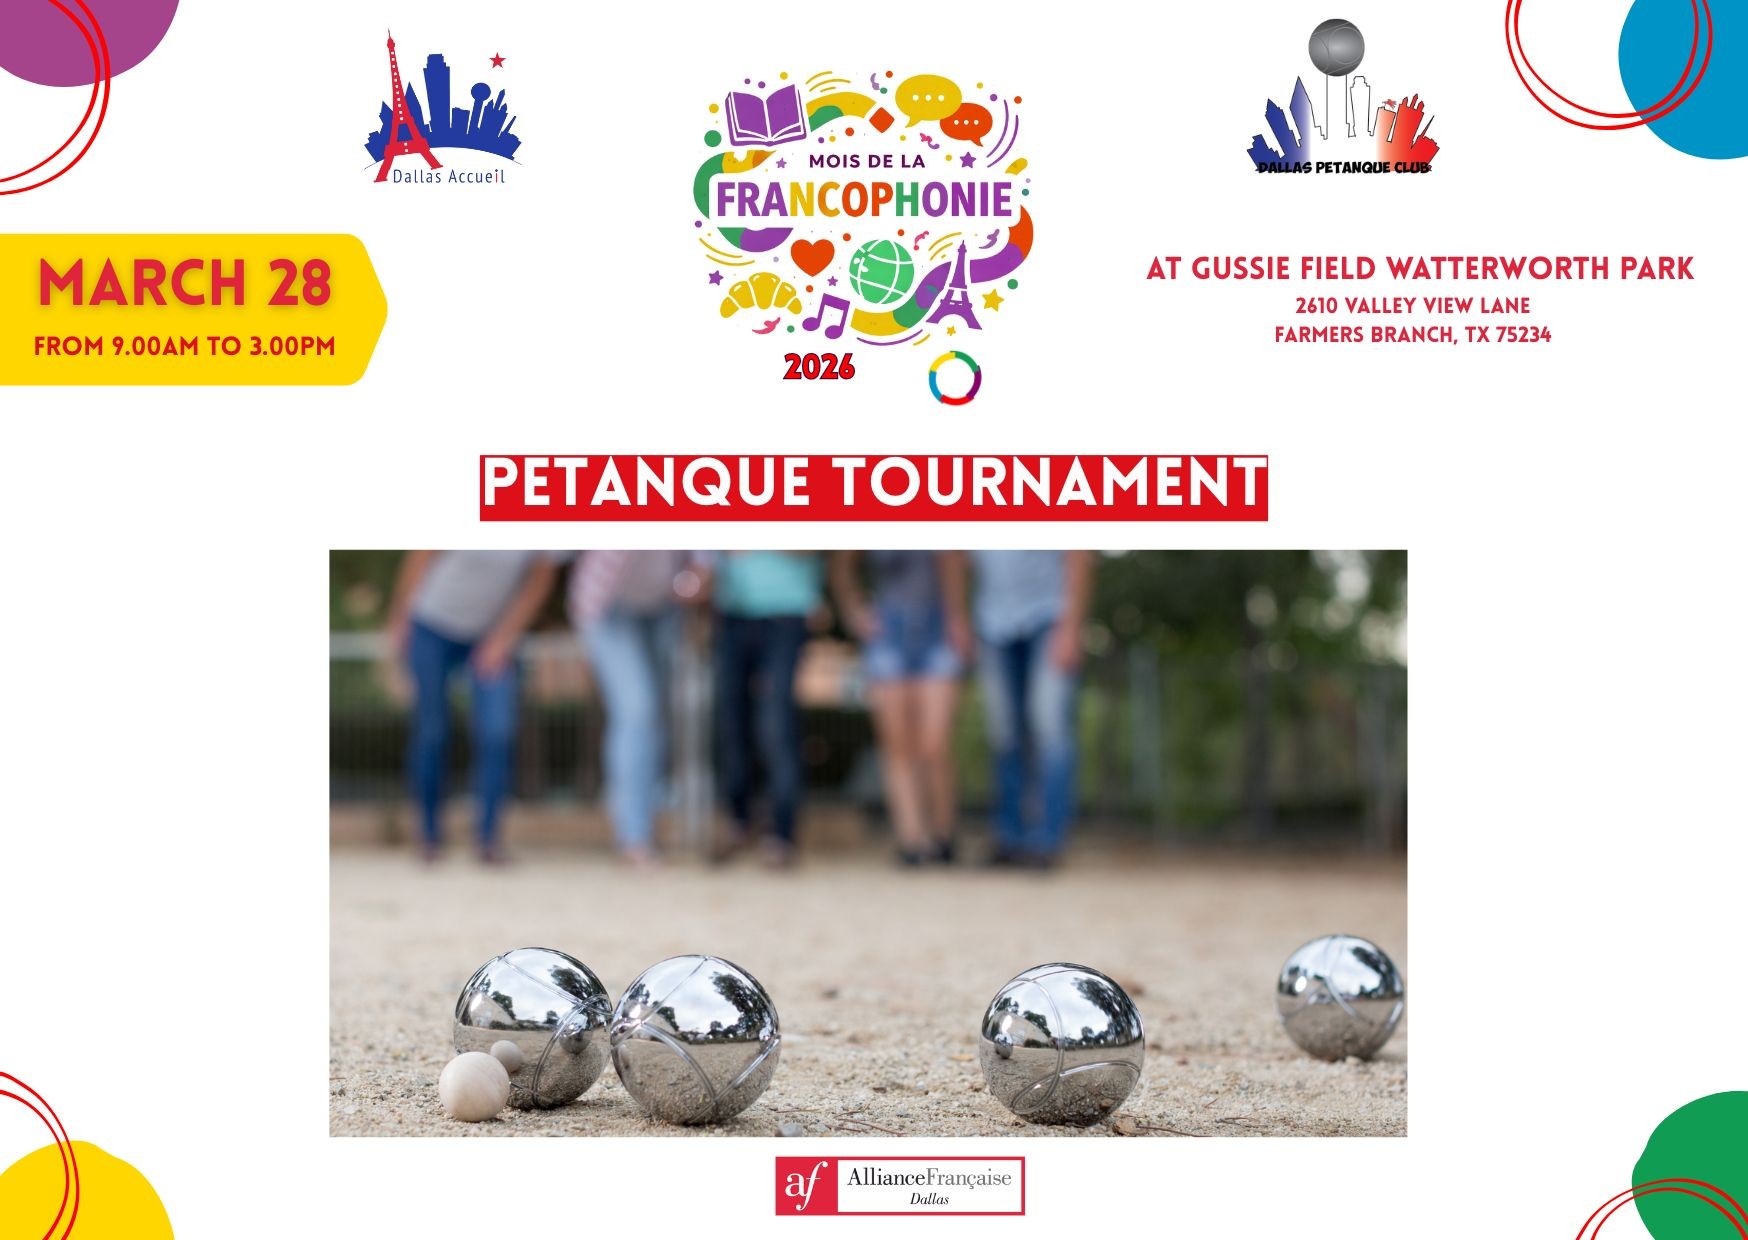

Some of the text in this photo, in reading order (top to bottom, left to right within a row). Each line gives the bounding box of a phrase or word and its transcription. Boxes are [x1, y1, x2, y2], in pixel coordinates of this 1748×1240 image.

[809, 154, 926, 169] MOIS DE LA
[1258, 161, 1431, 174] DALLAS PETANQUE CLUB
[393, 168, 505, 184] Dallas Accueil
[717, 180, 1013, 218] FRANCOPHONIE
[1146, 256, 1695, 280] AT GUSSIE FIELD WATTERWORTH PARK
[39, 257, 331, 307] MARCH 28
[1295, 296, 1531, 314] 2610 VALLEY VIEW LANE
[34, 335, 335, 356] FROM 9.00AM TO 3.00PM
[1275, 325, 1552, 346] FARMERS BRANCH, TX 75234
[782, 352, 856, 380] 2026
[483, 456, 1267, 507] PETANQUE TOURNAMENT
[909, 1192, 950, 1205] Dallas
